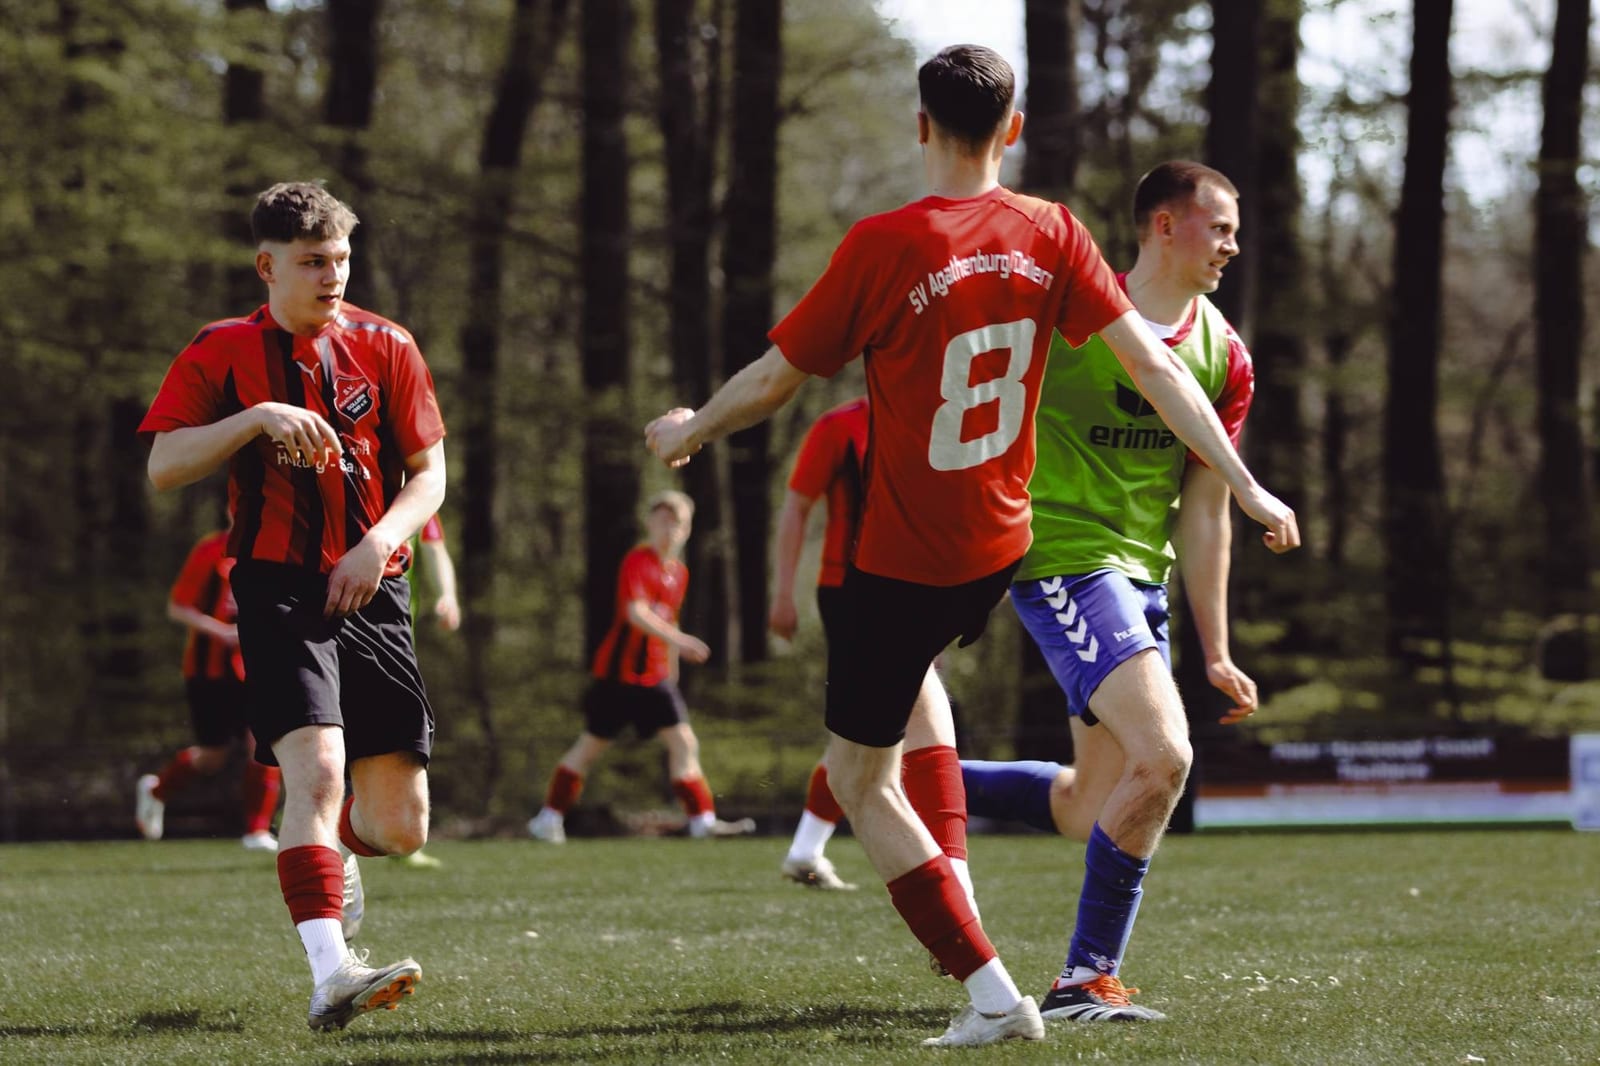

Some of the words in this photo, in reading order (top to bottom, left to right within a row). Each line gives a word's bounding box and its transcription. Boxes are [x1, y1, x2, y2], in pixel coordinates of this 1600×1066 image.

[908, 282, 929, 315] SV
[928, 318, 1037, 471] 8
[1089, 422, 1177, 449] erima
